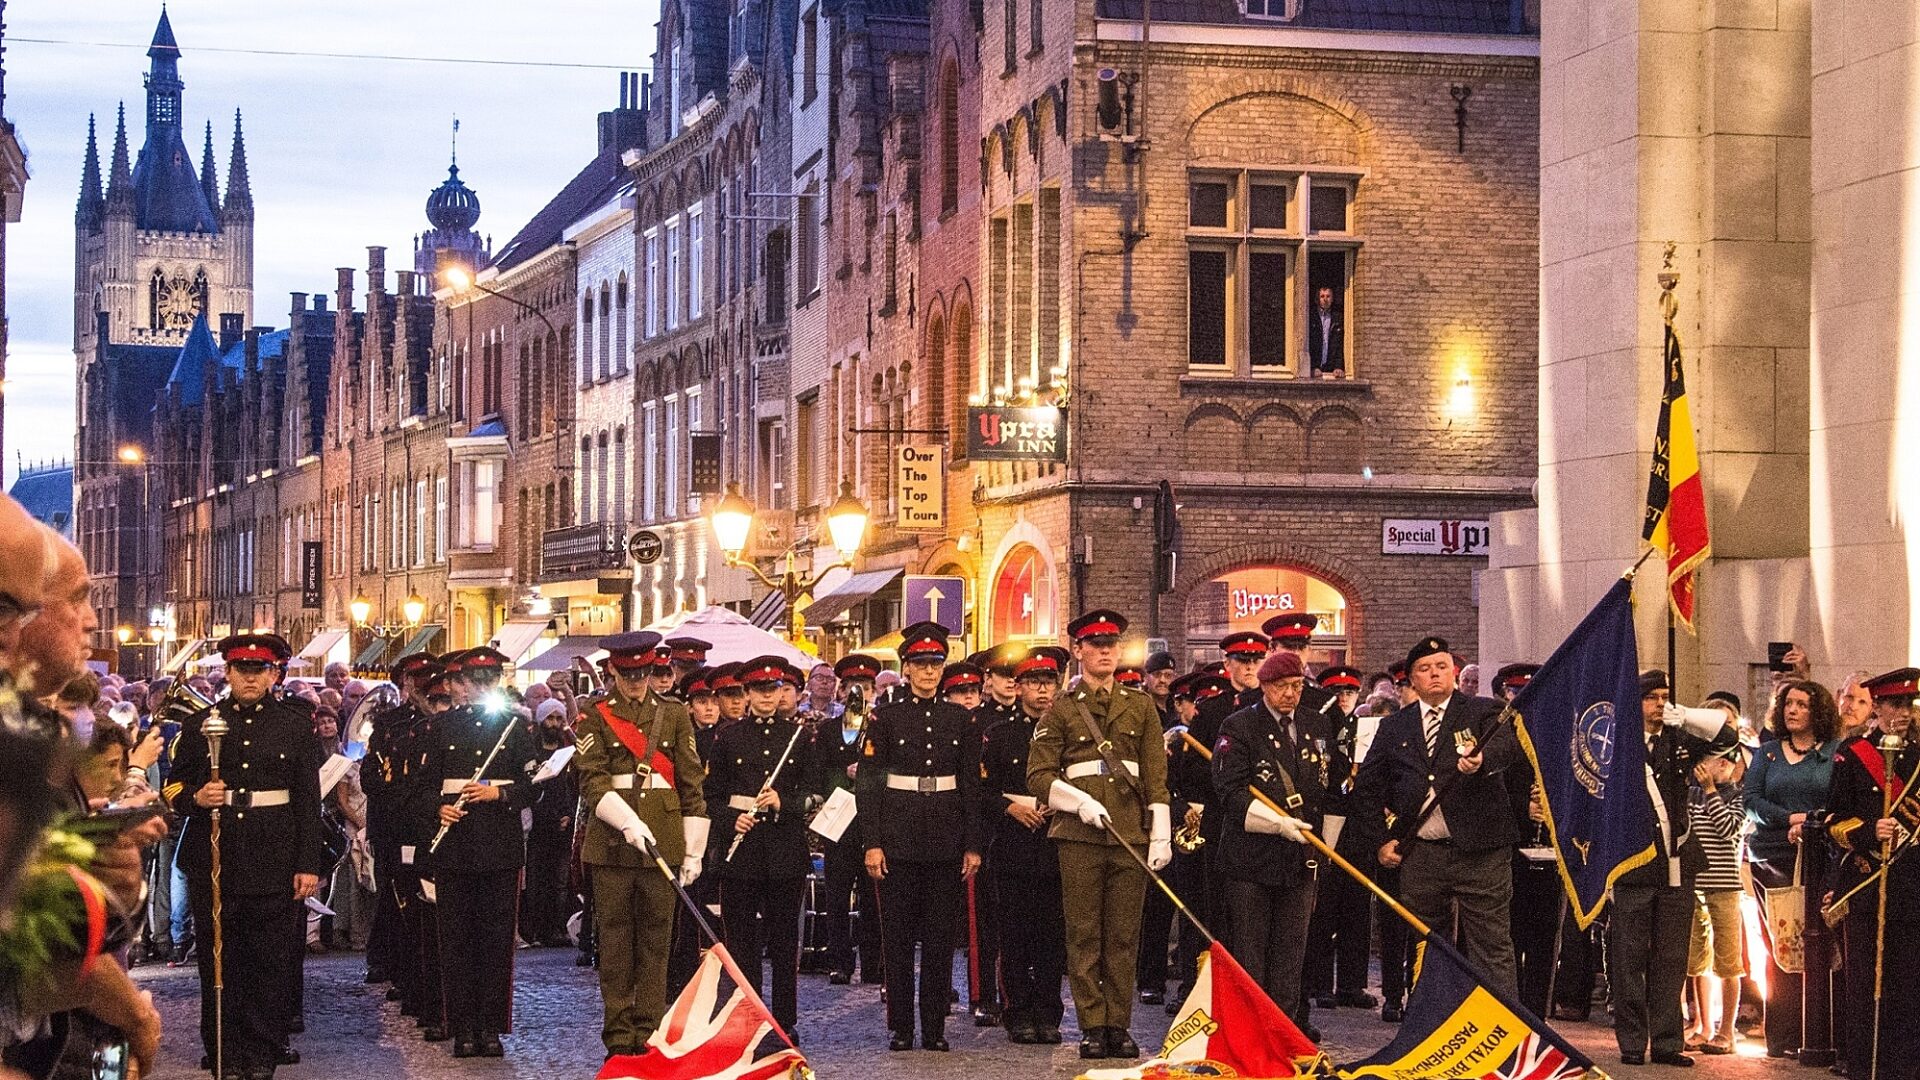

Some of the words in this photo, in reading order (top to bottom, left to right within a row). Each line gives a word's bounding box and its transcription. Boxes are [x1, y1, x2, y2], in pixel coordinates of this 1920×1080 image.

[979, 413, 1057, 446] Ypra
[1018, 440, 1057, 453] INN
[903, 447, 934, 462] Over
[902, 467, 927, 481] The
[902, 487, 928, 502] Top
[902, 507, 939, 520] Tours
[1388, 526, 1435, 547] Special
[1232, 588, 1295, 618] Ypra
[1465, 1024, 1509, 1064] ROYAL
